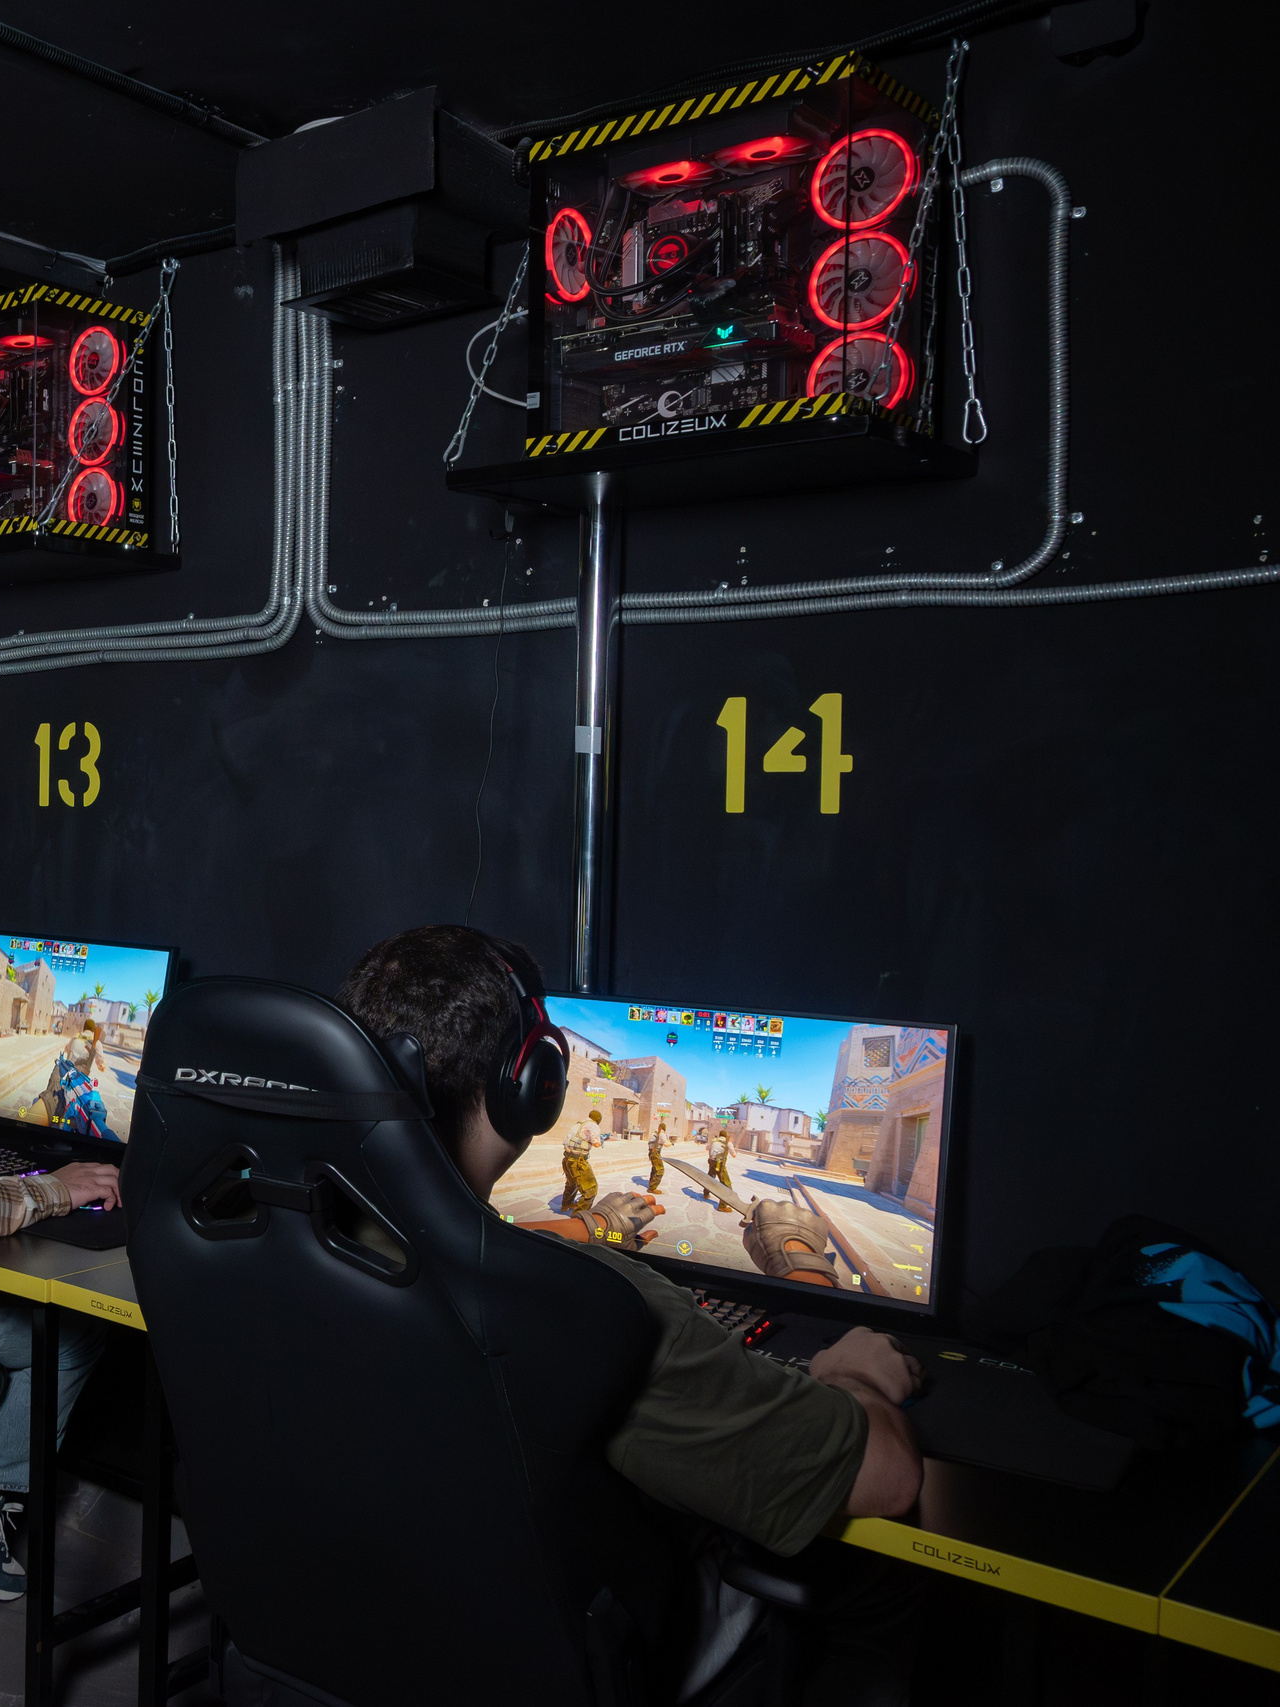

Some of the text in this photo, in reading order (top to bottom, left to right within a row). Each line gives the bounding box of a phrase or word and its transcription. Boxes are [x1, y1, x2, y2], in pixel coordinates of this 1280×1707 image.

[613, 344, 662, 362] GEFORCE
[130, 358, 144, 493] COLIZEUM
[618, 411, 728, 442] COLIZEUM
[33, 721, 103, 809] 13
[714, 691, 854, 815] 14
[607, 1230, 623, 1241] 100
[90, 1299, 133, 1319] COLIZEUM
[912, 1540, 1002, 1576] COLIZEUM
